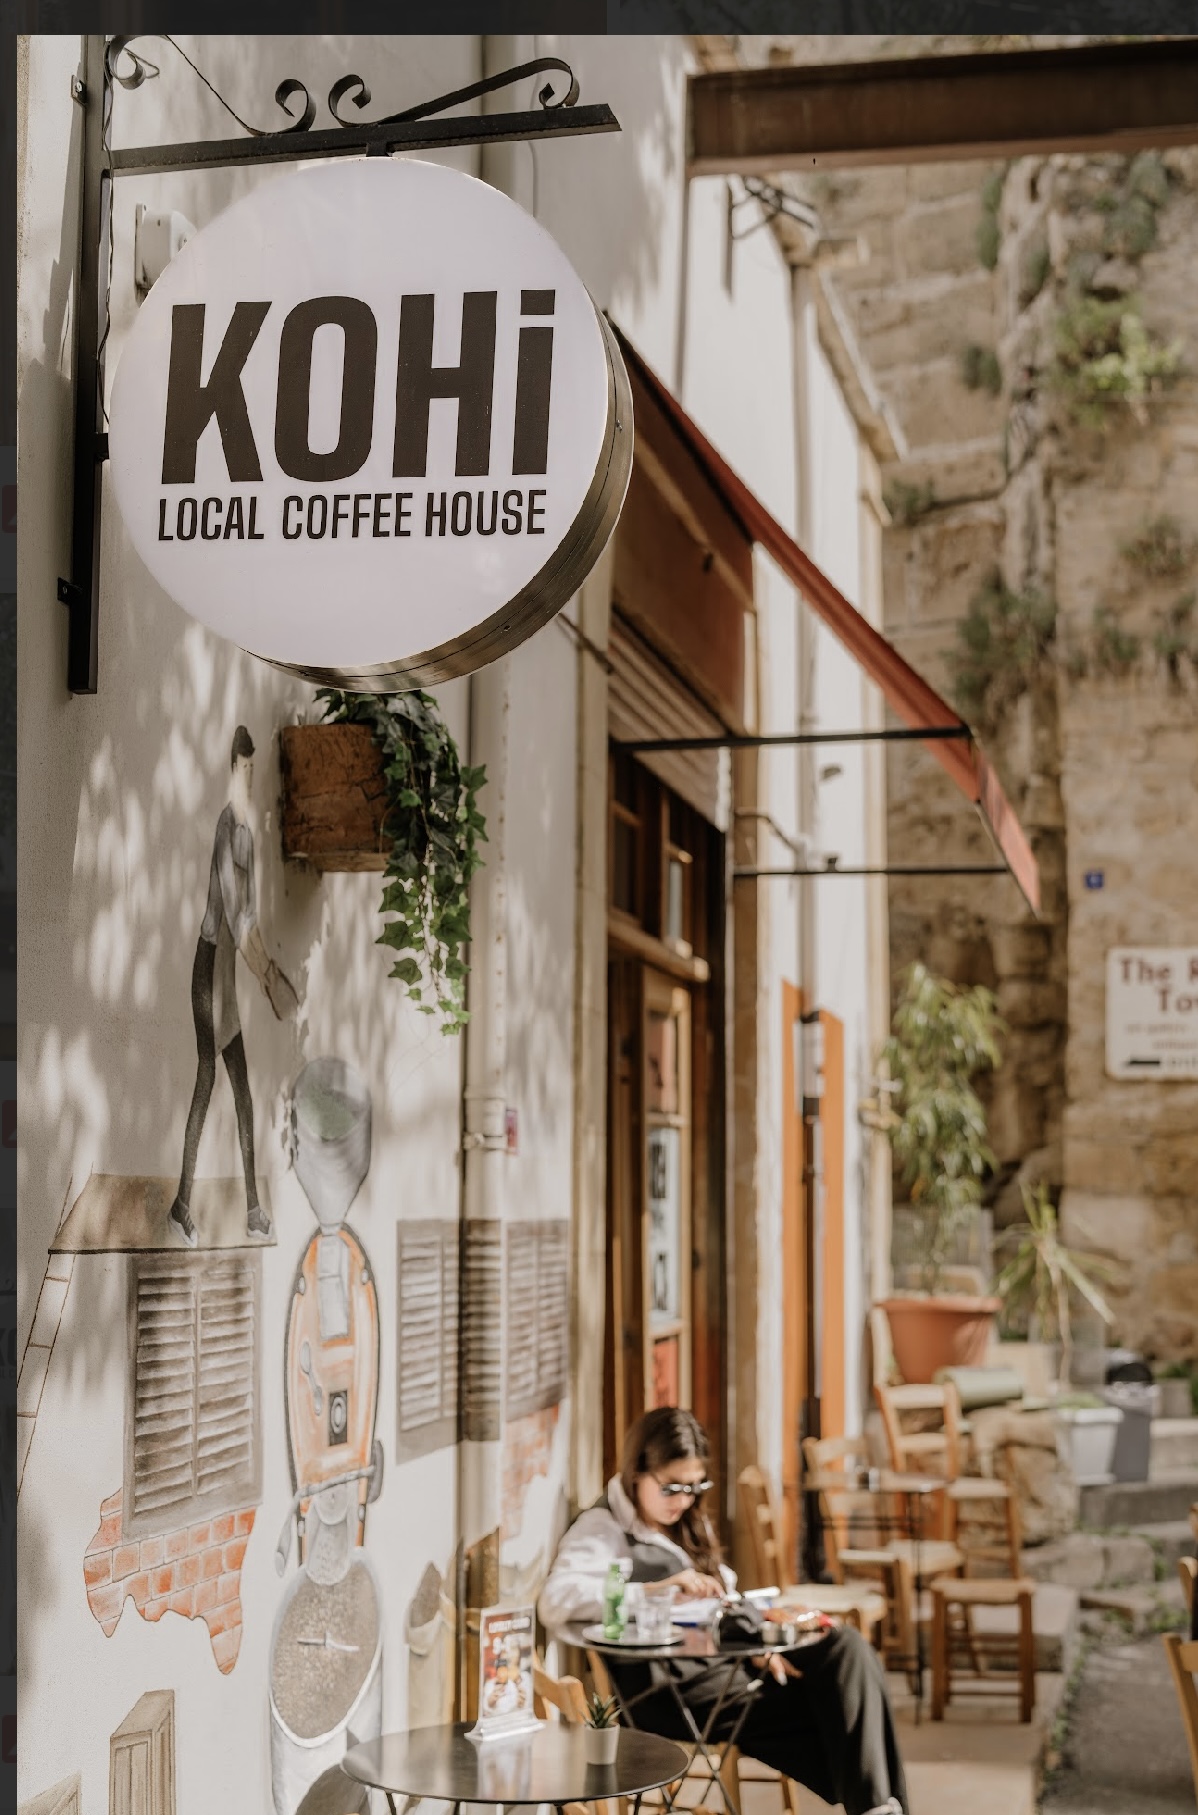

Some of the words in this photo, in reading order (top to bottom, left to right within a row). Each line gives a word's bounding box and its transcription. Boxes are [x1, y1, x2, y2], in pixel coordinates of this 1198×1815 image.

[161, 289, 556, 485] KOHi
[158, 496, 265, 541] LOCAL
[282, 492, 413, 539] COFFEE
[424, 489, 547, 537] HOUSE
[1119, 957, 1171, 984] The
